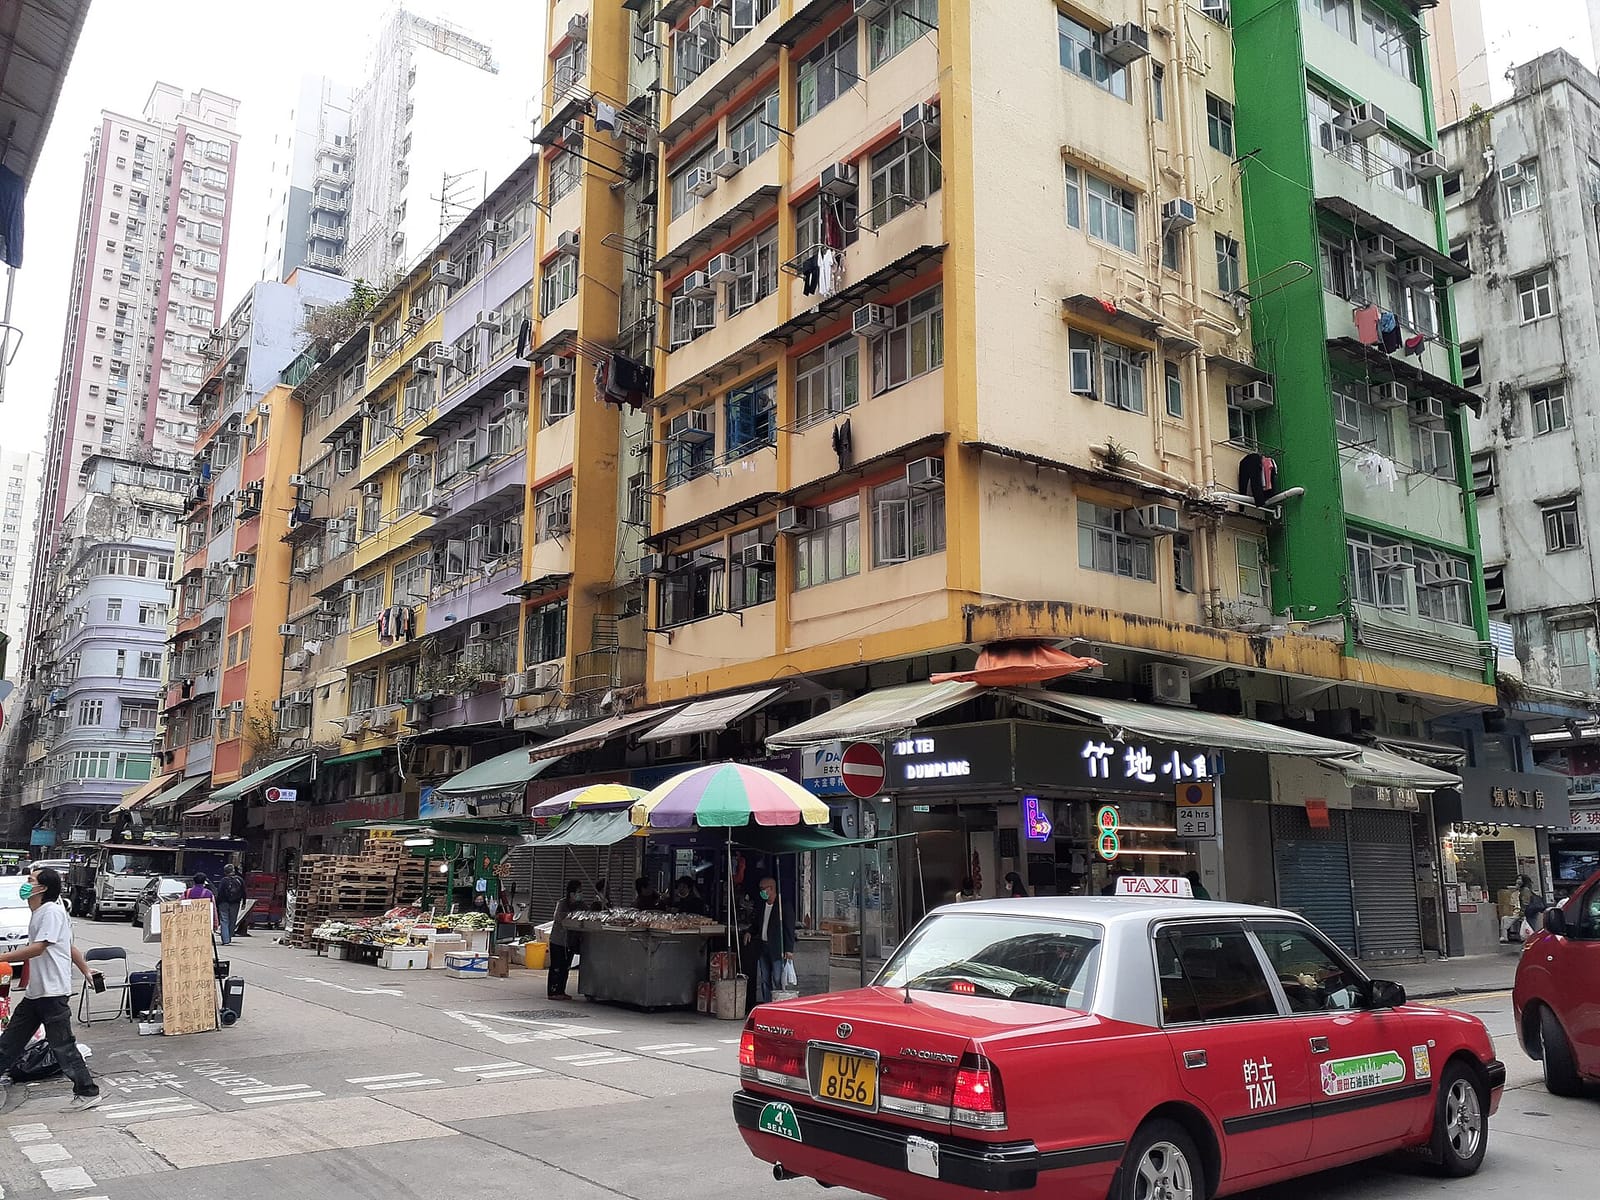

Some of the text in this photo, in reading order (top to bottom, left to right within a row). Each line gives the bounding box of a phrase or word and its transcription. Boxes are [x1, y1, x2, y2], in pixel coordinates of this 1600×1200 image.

[906, 760, 970, 780] DUMPLING
[1180, 809, 1210, 819] 24 hrs
[1183, 821, 1207, 833] 全日
[1122, 878, 1178, 894] TAXI
[918, 1050, 959, 1063] COMFORT
[838, 1056, 861, 1079] UV
[1243, 1056, 1273, 1083] 的士
[827, 1076, 867, 1102] 8156
[1246, 1080, 1277, 1109] TAXI
[773, 1102, 790, 1114] TAXI
[774, 1111, 784, 1126] 4
[767, 1122, 793, 1137] SEATS
